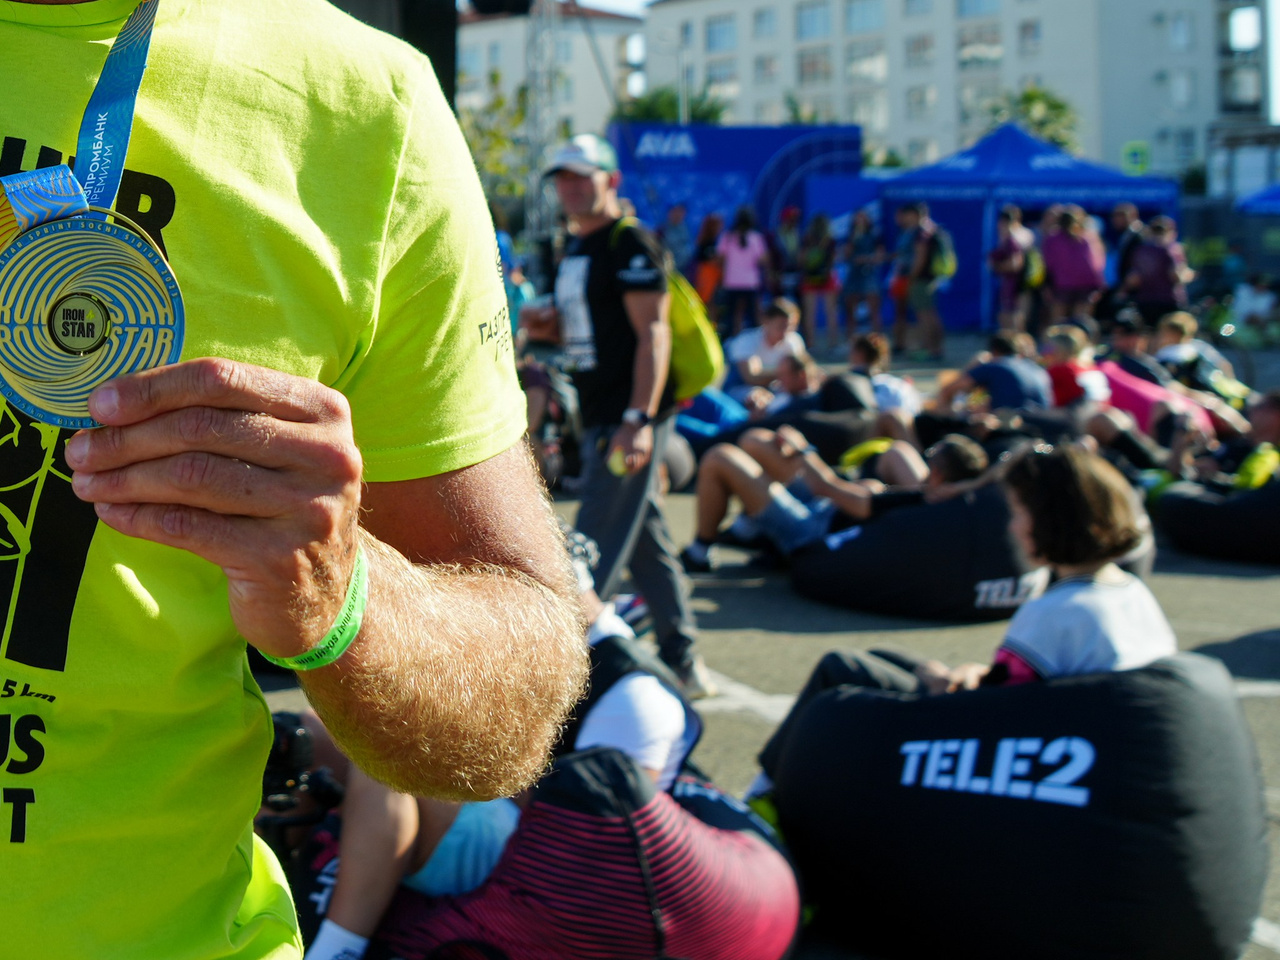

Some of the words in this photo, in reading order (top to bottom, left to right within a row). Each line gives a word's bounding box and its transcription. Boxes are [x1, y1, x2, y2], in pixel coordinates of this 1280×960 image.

[83, 111, 109, 198] ЗПРОМБАНК
[28, 221, 73, 241] SPRINT
[79, 221, 118, 236] SOCHI
[124, 233, 160, 264] SIRIUS
[61, 321, 95, 338] STAR
[62, 308, 85, 321] IRON
[0, 679, 18, 699] 5
[20, 683, 57, 703] km
[899, 736, 1096, 808] TELE2
